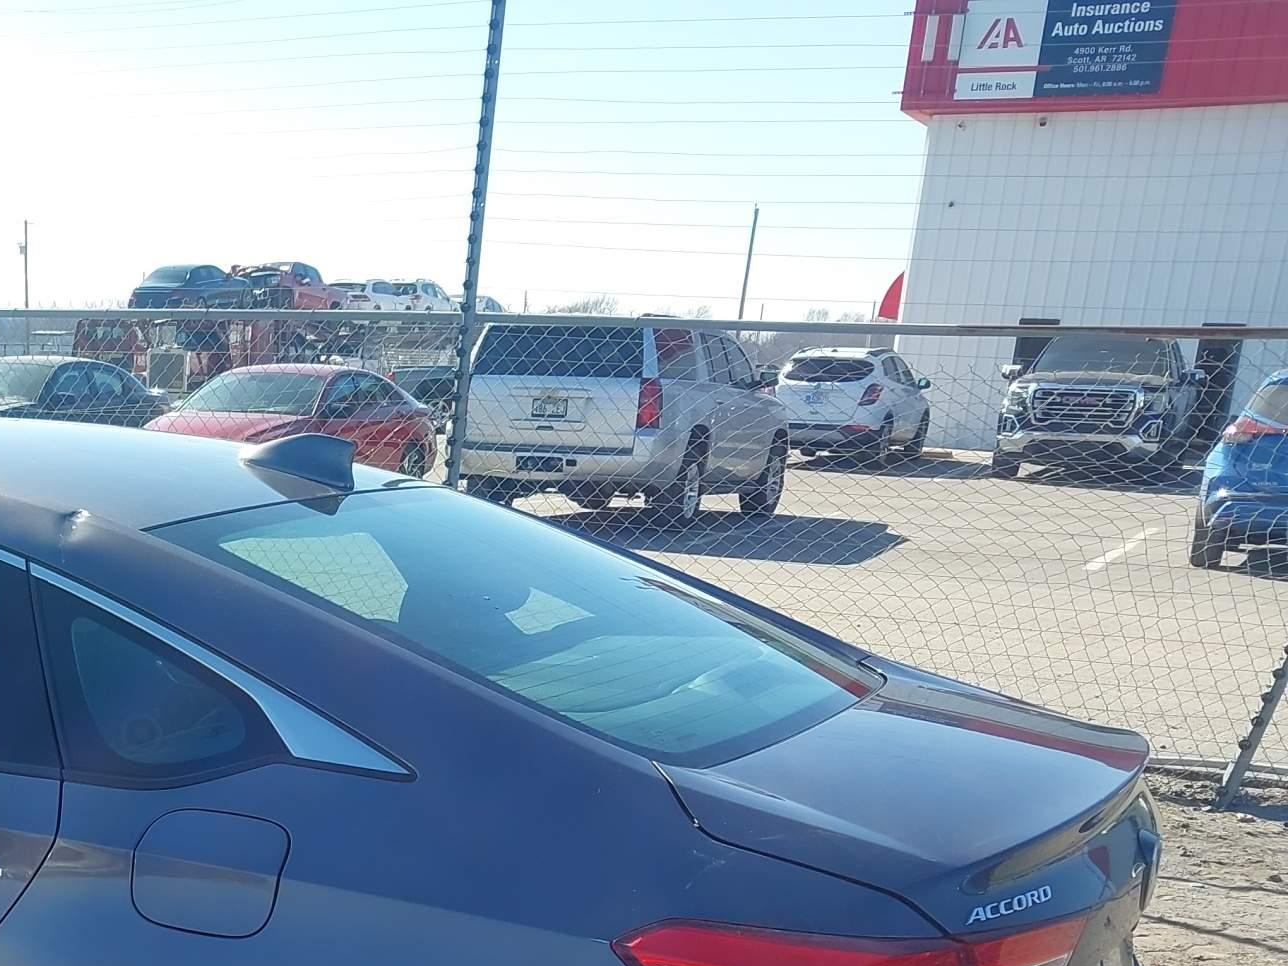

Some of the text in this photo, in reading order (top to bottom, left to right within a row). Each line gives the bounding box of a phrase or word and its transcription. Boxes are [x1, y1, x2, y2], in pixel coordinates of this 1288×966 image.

[1071, 1, 1151, 18] Insurance
[1051, 18, 1164, 37] Auto Auctions
[1074, 44, 1133, 55] 4900 Kerr Rd.
[1067, 53, 1137, 65] Scott, AR 72142
[971, 81, 1017, 92] Little Rock
[965, 885, 1053, 926] ACCORD
